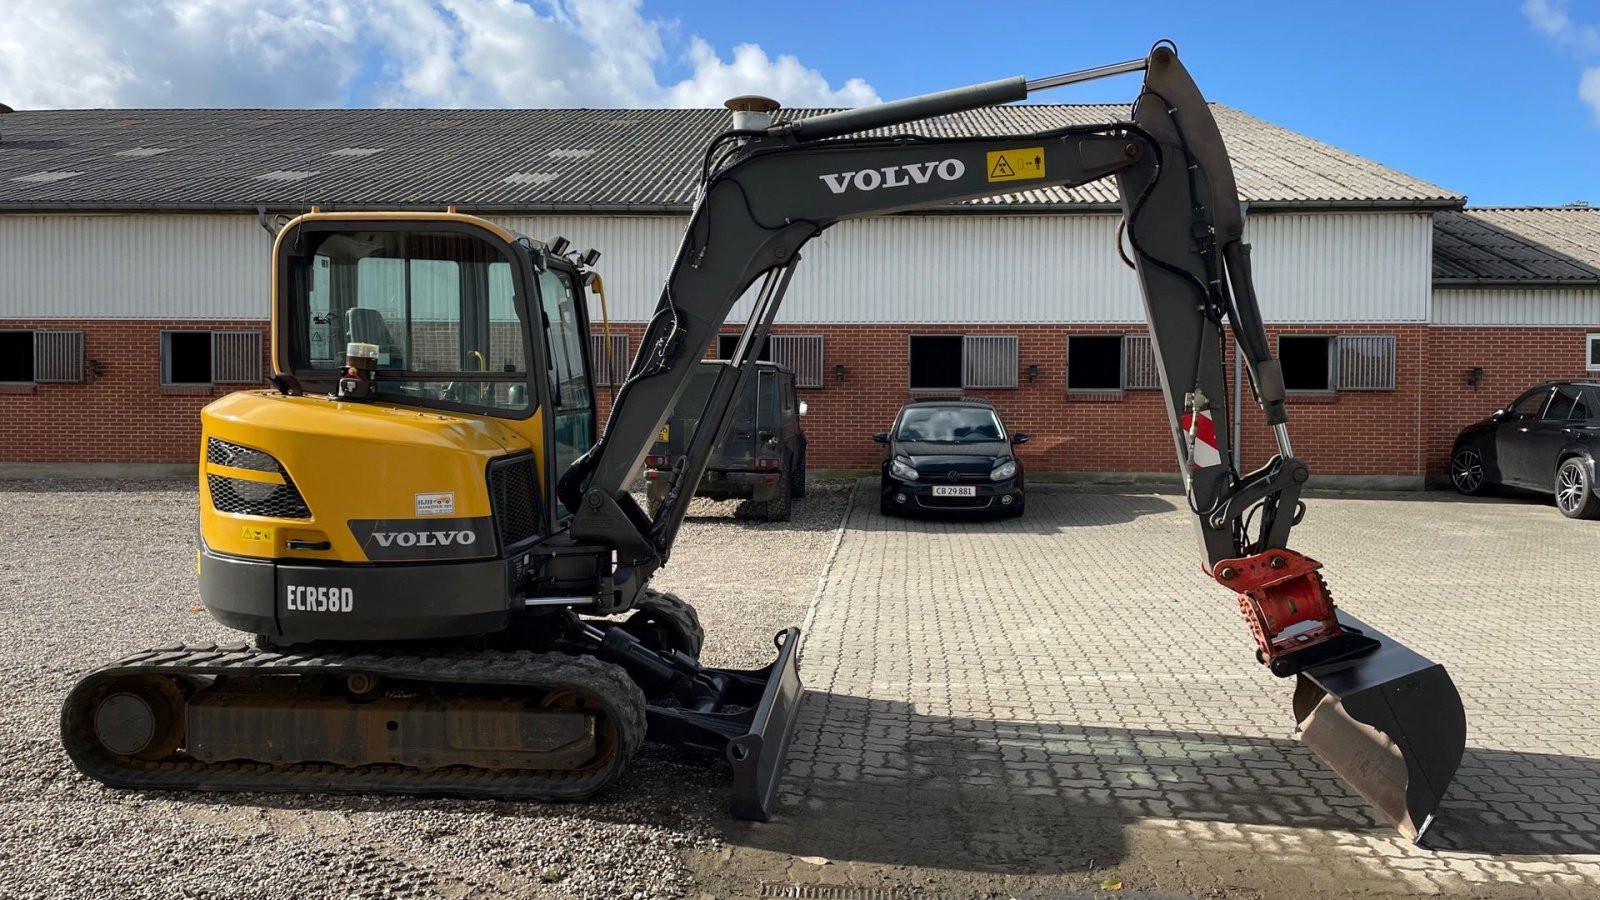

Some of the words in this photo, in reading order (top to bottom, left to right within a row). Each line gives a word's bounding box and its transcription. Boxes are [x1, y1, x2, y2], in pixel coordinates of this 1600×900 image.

[819, 158, 965, 194] VOLVO
[936, 487, 947, 496] CB
[948, 487, 958, 496] 29
[958, 487, 972, 496] 881
[371, 530, 476, 547] VOLVO
[287, 585, 354, 613] ECR58D
